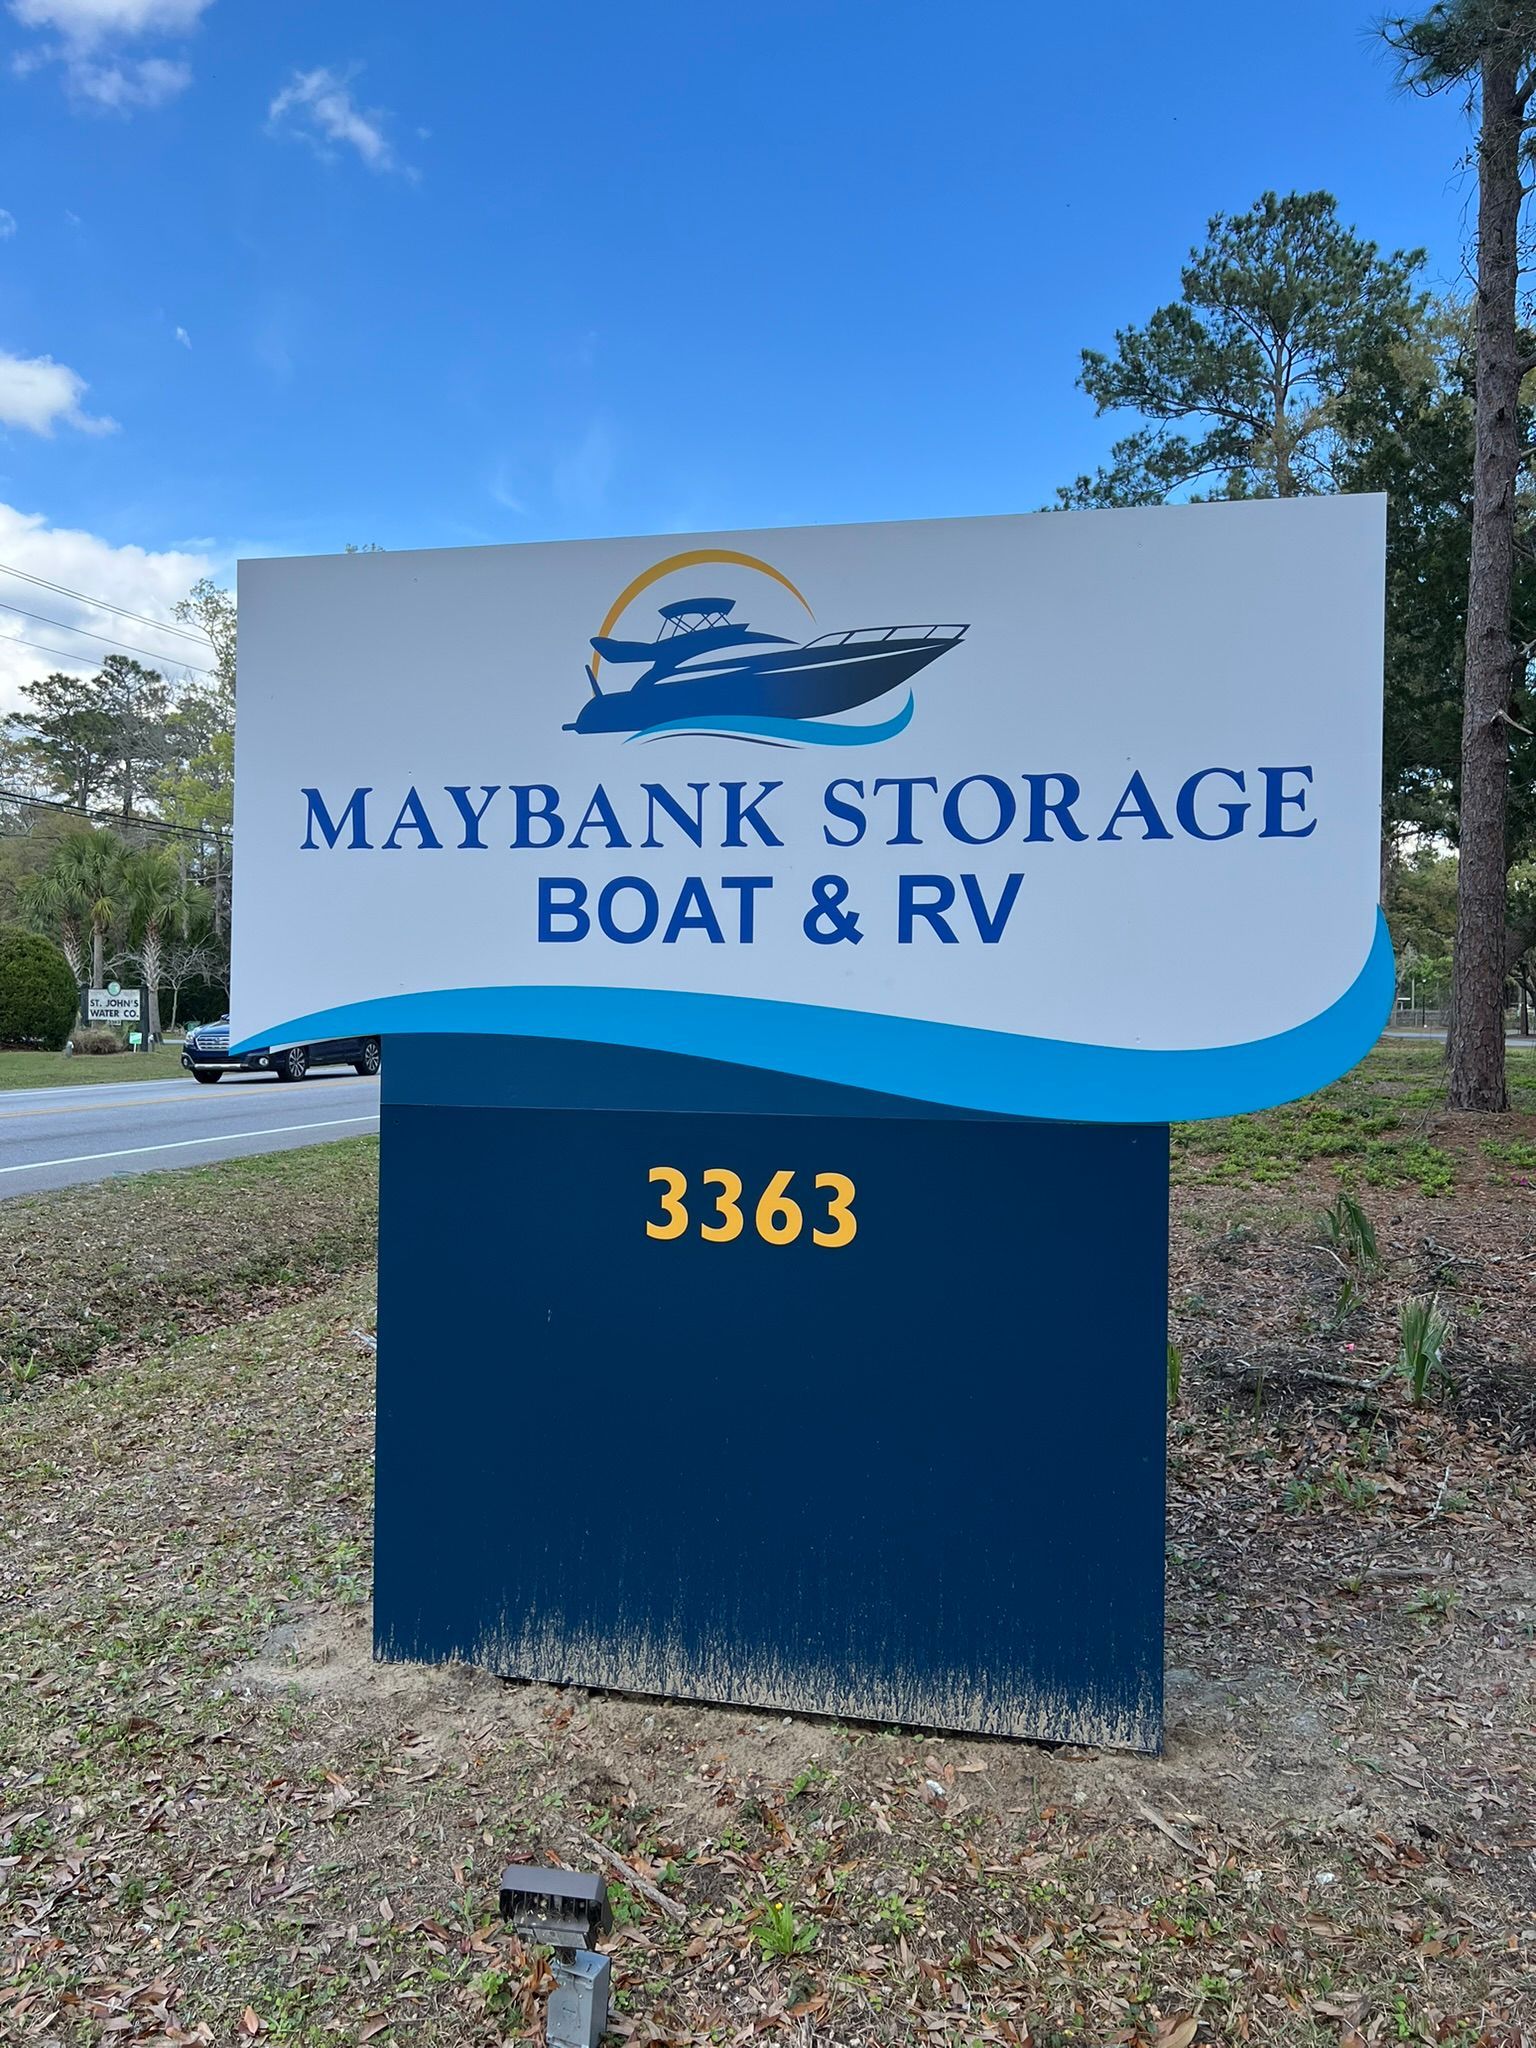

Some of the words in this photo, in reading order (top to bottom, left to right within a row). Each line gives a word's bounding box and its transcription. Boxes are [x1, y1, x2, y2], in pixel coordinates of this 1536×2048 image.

[300, 781, 784, 849] MAYBANK
[824, 765, 1317, 846] STORAGE
[538, 876, 773, 944] BOAT
[803, 875, 864, 945] &
[898, 873, 1024, 943] RV
[90, 999, 102, 1007] ST.
[106, 999, 139, 1007] JOHN'S
[90, 1009, 119, 1017] WATER
[124, 1009, 139, 1017] CO.
[646, 1166, 857, 1248] 3363
